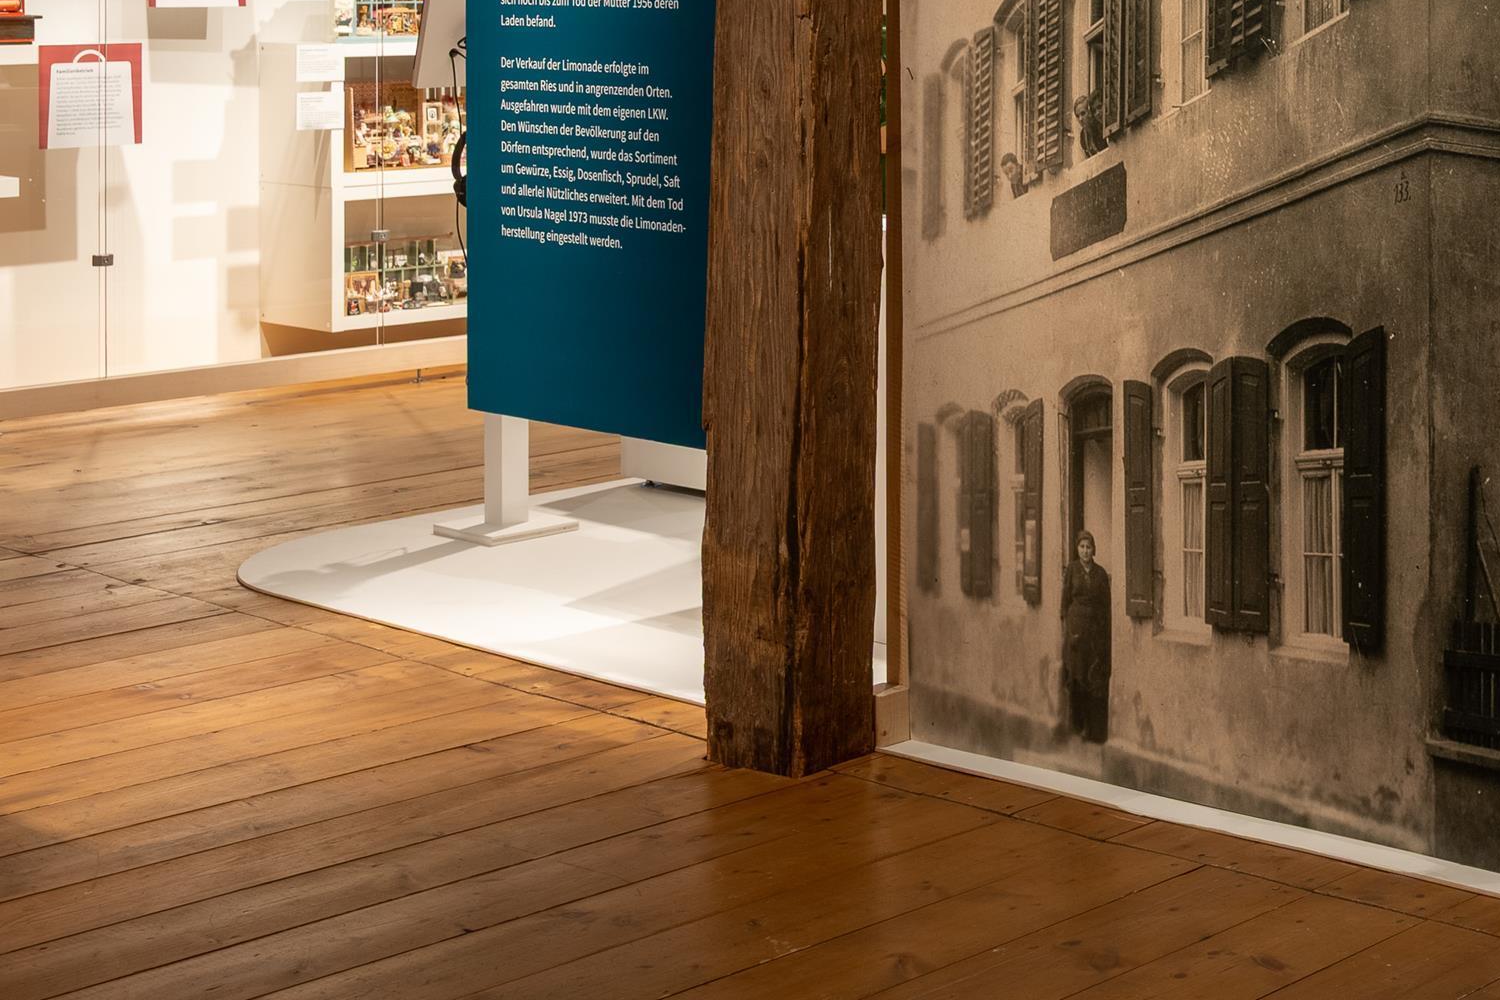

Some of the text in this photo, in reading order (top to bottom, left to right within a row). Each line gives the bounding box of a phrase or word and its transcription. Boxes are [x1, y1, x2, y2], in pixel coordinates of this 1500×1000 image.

[501, 15, 556, 27] Laden befand.
[501, 57, 649, 77] Der Verkauf der Limonade erfolgte im
[501, 163, 680, 188] um Gewürze, Essig, Dosenfisch, Sprudel, Saft
[501, 184, 683, 210] und allerlei Nützliches erweitert. Mit dem Tod
[501, 206, 686, 232] von Ursula Nagel 1973 musste die Limonaden-
[501, 225, 623, 248] herstellung eingestellt werden.
